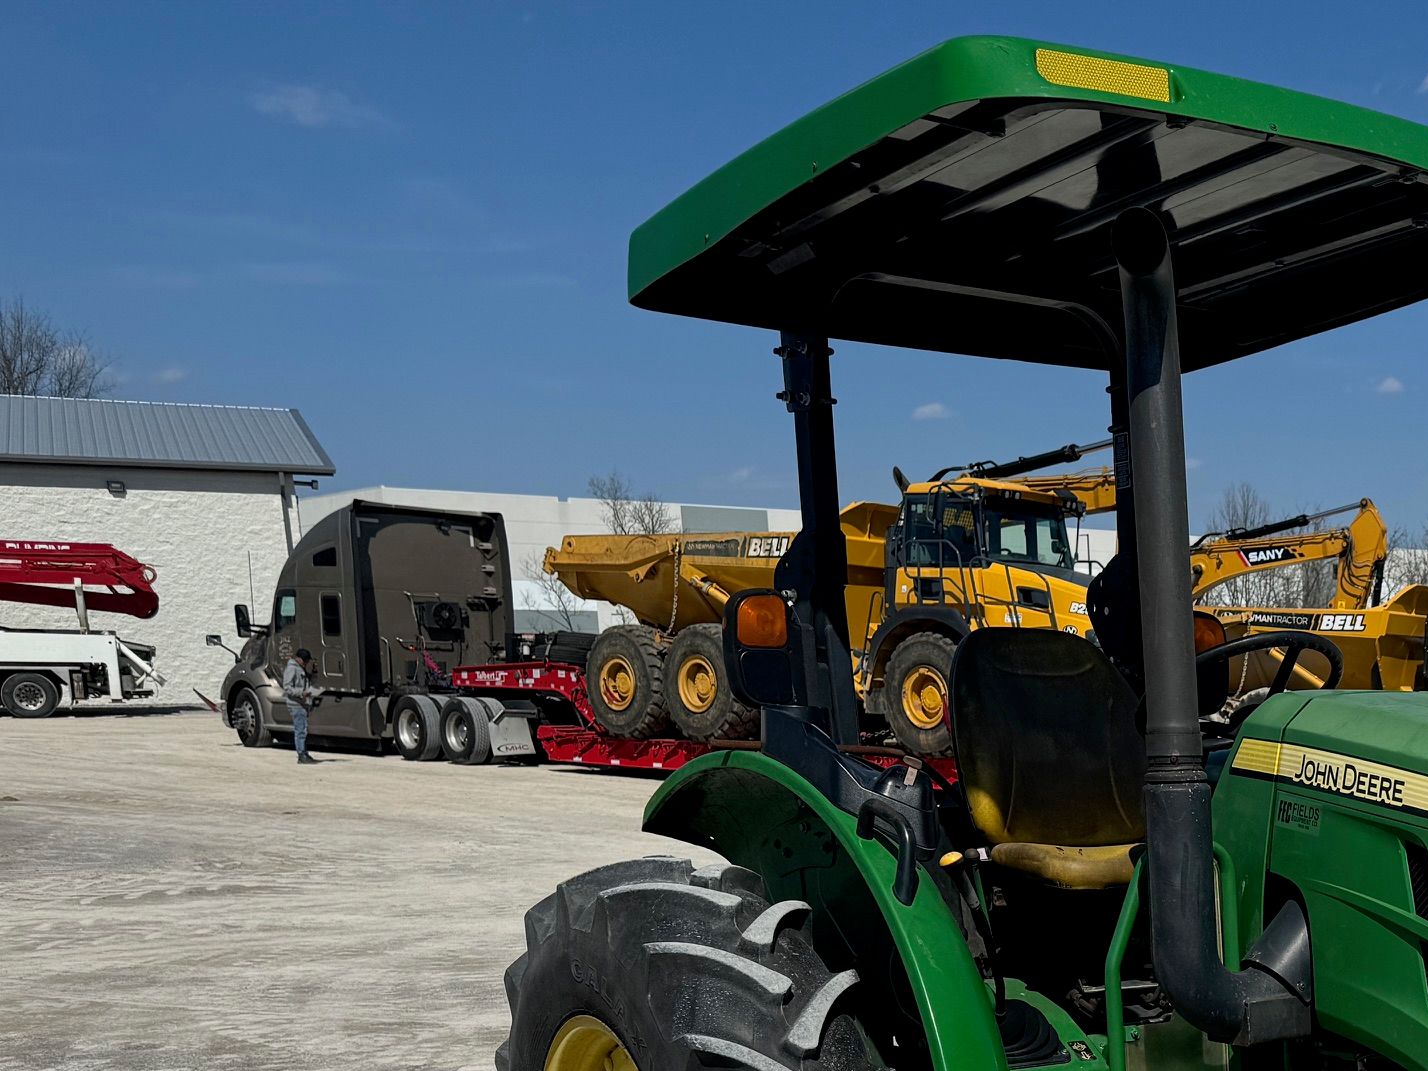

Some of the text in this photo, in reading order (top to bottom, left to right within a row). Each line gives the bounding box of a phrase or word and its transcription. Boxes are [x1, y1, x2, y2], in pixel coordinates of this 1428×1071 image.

[1249, 548, 1285, 563] SANY
[1320, 614, 1366, 631] BELL
[475, 670, 495, 681] Talbert
[1294, 754, 1406, 804] JOHN DEERE
[1292, 803, 1320, 821] FIELDS
